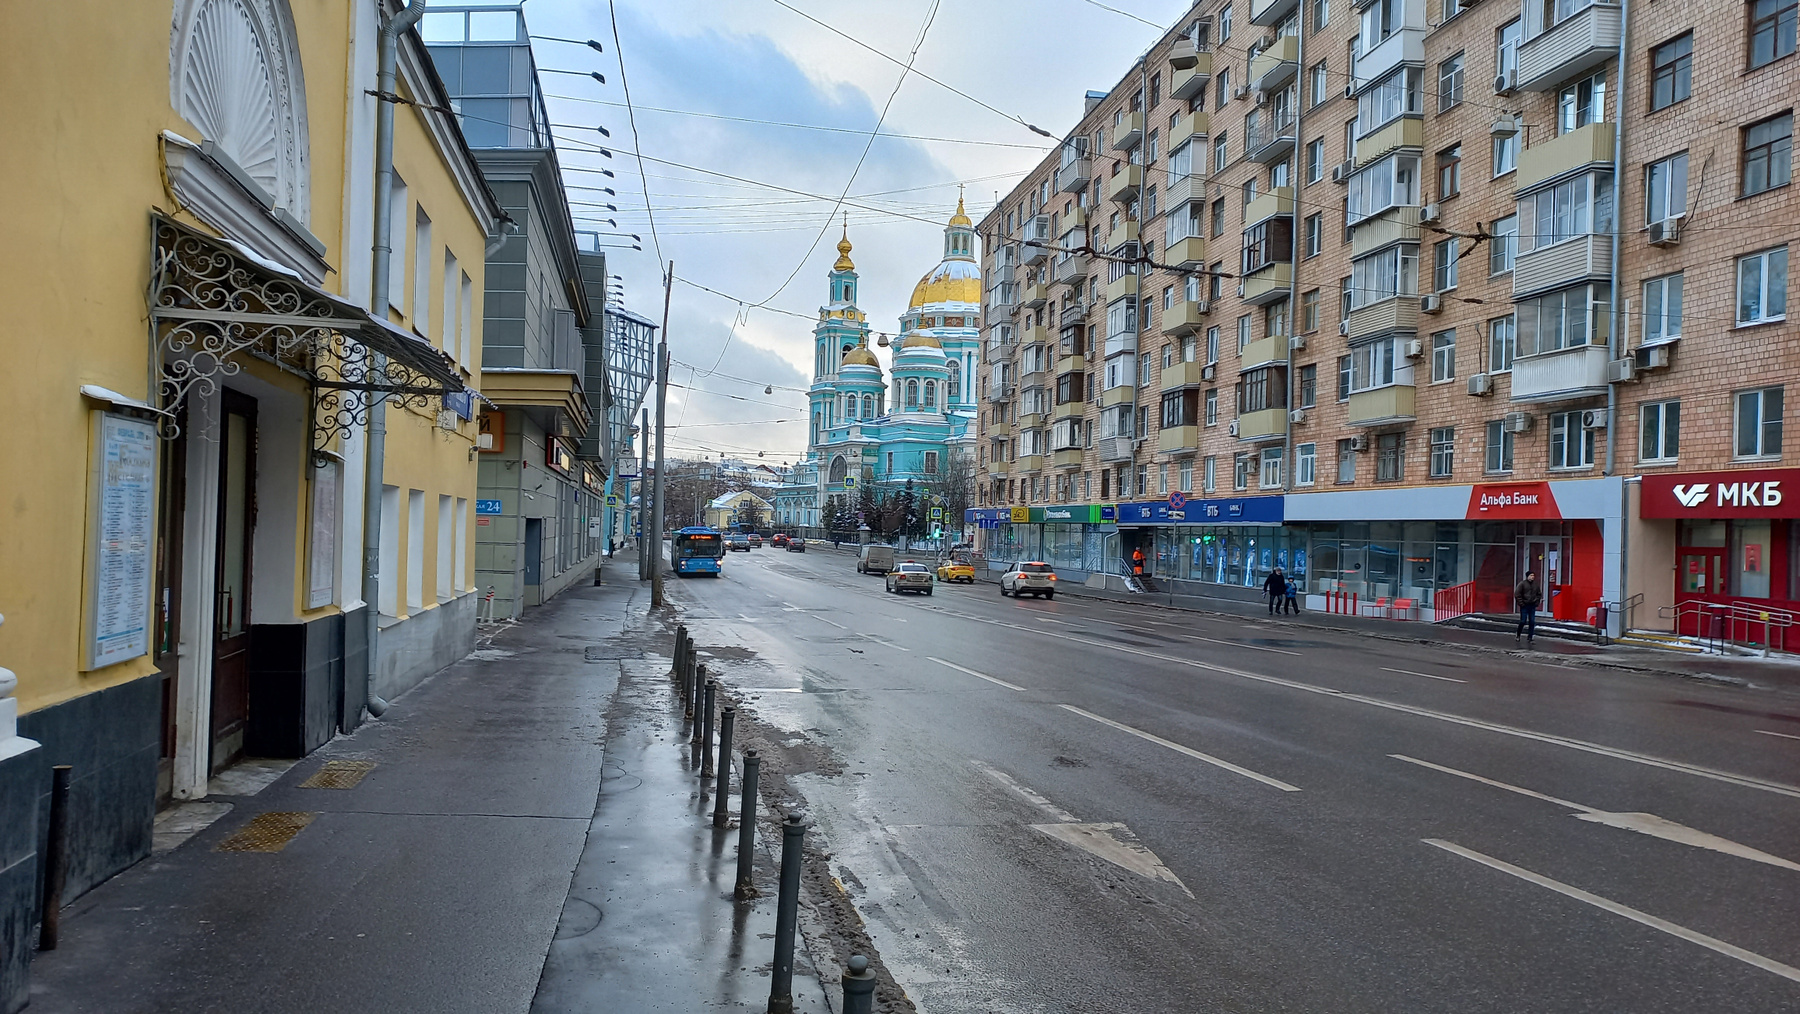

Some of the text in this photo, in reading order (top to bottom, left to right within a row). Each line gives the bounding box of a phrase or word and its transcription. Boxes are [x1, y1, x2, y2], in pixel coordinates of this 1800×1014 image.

[1480, 491, 1538, 509] Альфа Банк
[1717, 481, 1782, 507] МКБ
[486, 501, 500, 512] 24
[1207, 506, 1218, 516] ВТБ
